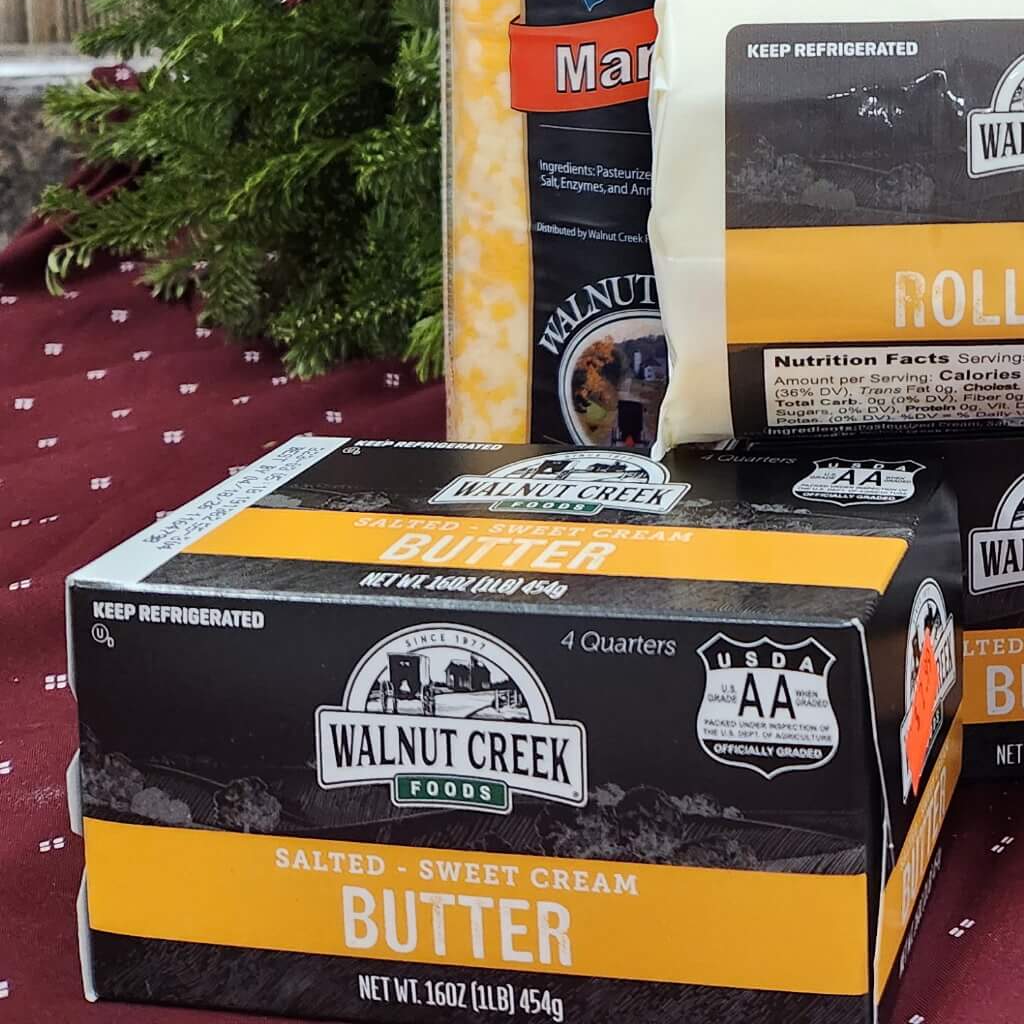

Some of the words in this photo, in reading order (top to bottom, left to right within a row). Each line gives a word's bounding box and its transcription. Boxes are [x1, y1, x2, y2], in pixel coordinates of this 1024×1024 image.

[747, 43, 791, 58] KEEP
[794, 41, 919, 57] REFRIGERATED
[556, 39, 658, 94] Mar
[539, 159, 595, 178] Ingredients:
[538, 273, 656, 356] WALNUT
[775, 355, 877, 367] Nutrition
[887, 353, 949, 364] Facts
[454, 481, 574, 499] WALNUT
[578, 486, 674, 505] CREEK
[353, 517, 460, 531] SALTED
[488, 523, 587, 538] SWEET
[592, 528, 695, 543] CREAM
[379, 533, 616, 571] BUTTER
[92, 602, 135, 621] KEEP
[139, 605, 264, 629] REFRIGERATED
[405, 632, 447, 649] SINCE
[455, 635, 488, 650] 1977
[561, 631, 575, 651] 4
[580, 631, 677, 658] Quarters
[738, 672, 796, 719] AA
[331, 724, 458, 773] WALNUT
[468, 733, 572, 786] CREEK
[714, 744, 774, 756] OFFICIALLY
[776, 747, 822, 759] GRADED
[996, 743, 1023, 766] NET
[410, 779, 493, 803] FOODS
[275, 848, 385, 876] SALTED
[419, 860, 521, 888] SWEET
[531, 868, 639, 897] CREAM
[342, 885, 573, 967] BUTTER
[358, 975, 390, 1002] NET
[394, 977, 423, 1006] WT.
[471, 982, 515, 1016] (1LB)
[520, 988, 563, 1022] 454g
